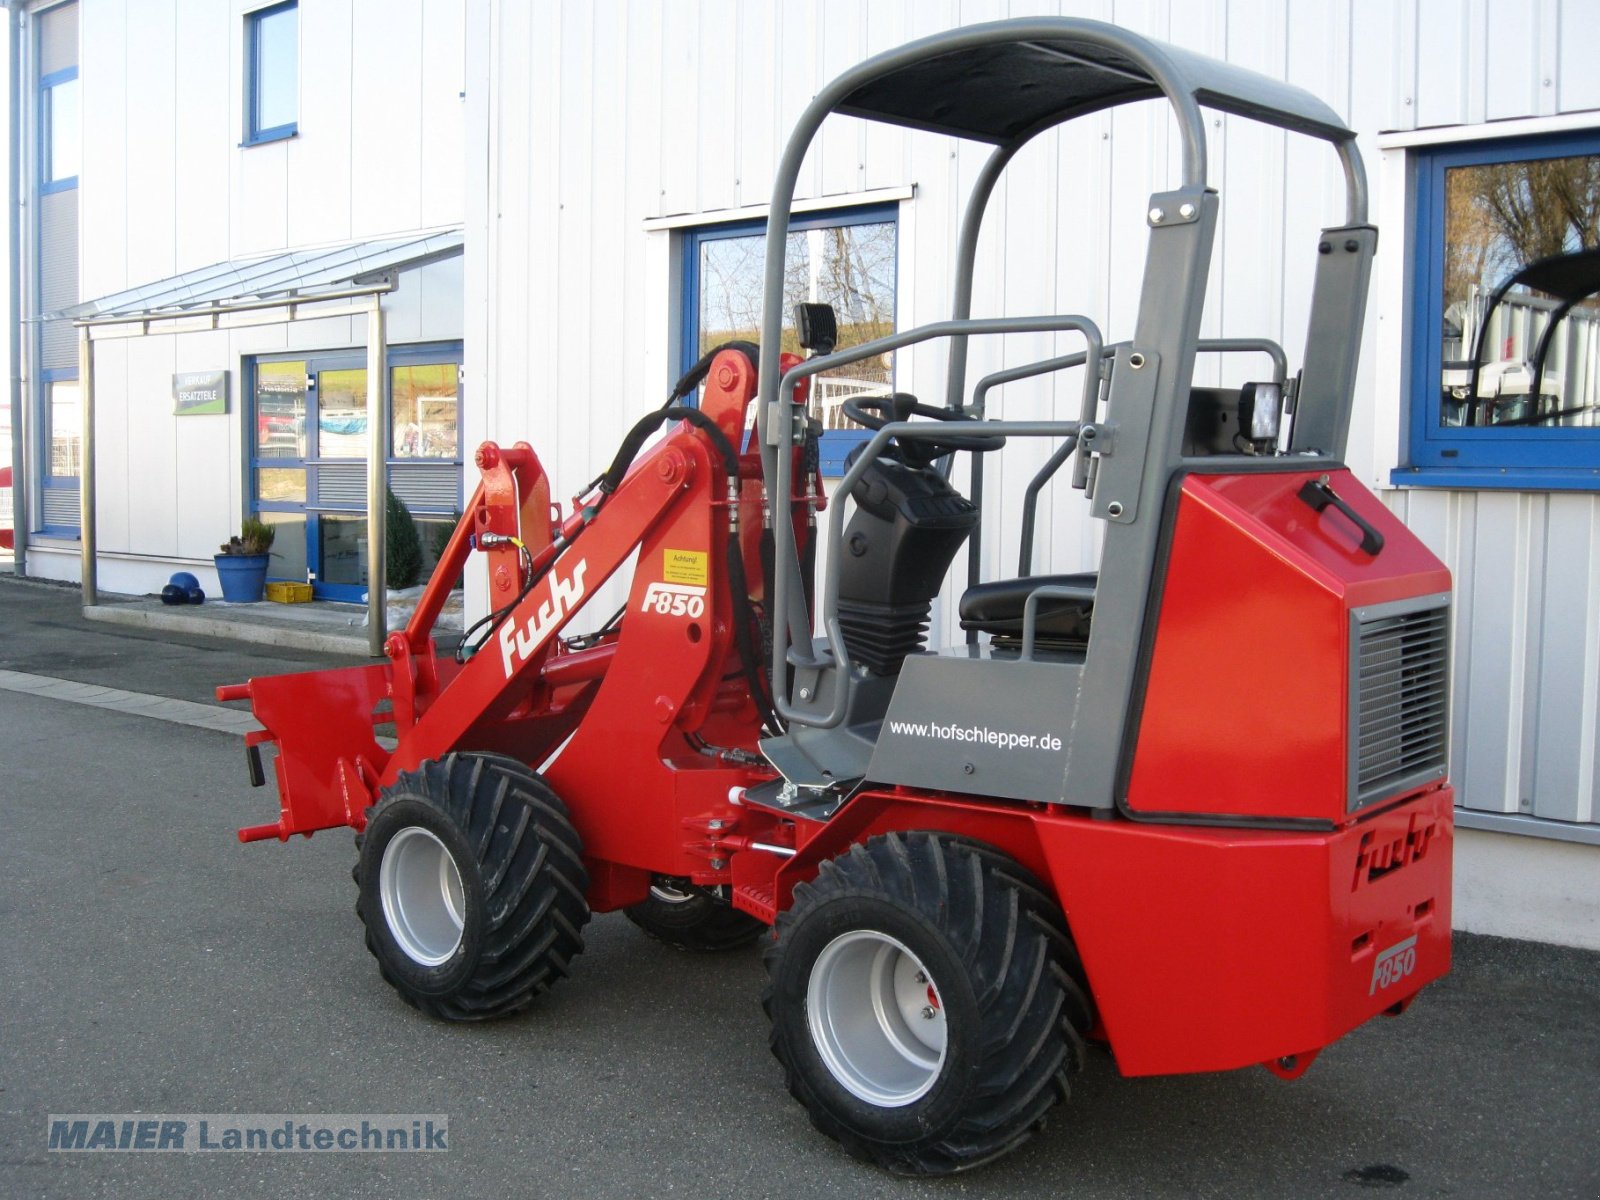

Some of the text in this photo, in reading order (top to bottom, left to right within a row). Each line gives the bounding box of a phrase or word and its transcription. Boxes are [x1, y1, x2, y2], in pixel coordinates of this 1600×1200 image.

[179, 390, 217, 401] ERSATZTEILE
[673, 554, 698, 564] Achtung!
[641, 582, 707, 618] F850
[499, 558, 587, 679] Fuchs
[890, 721, 1062, 751] www.hofschlepper.de
[1369, 935, 1418, 996] F850
